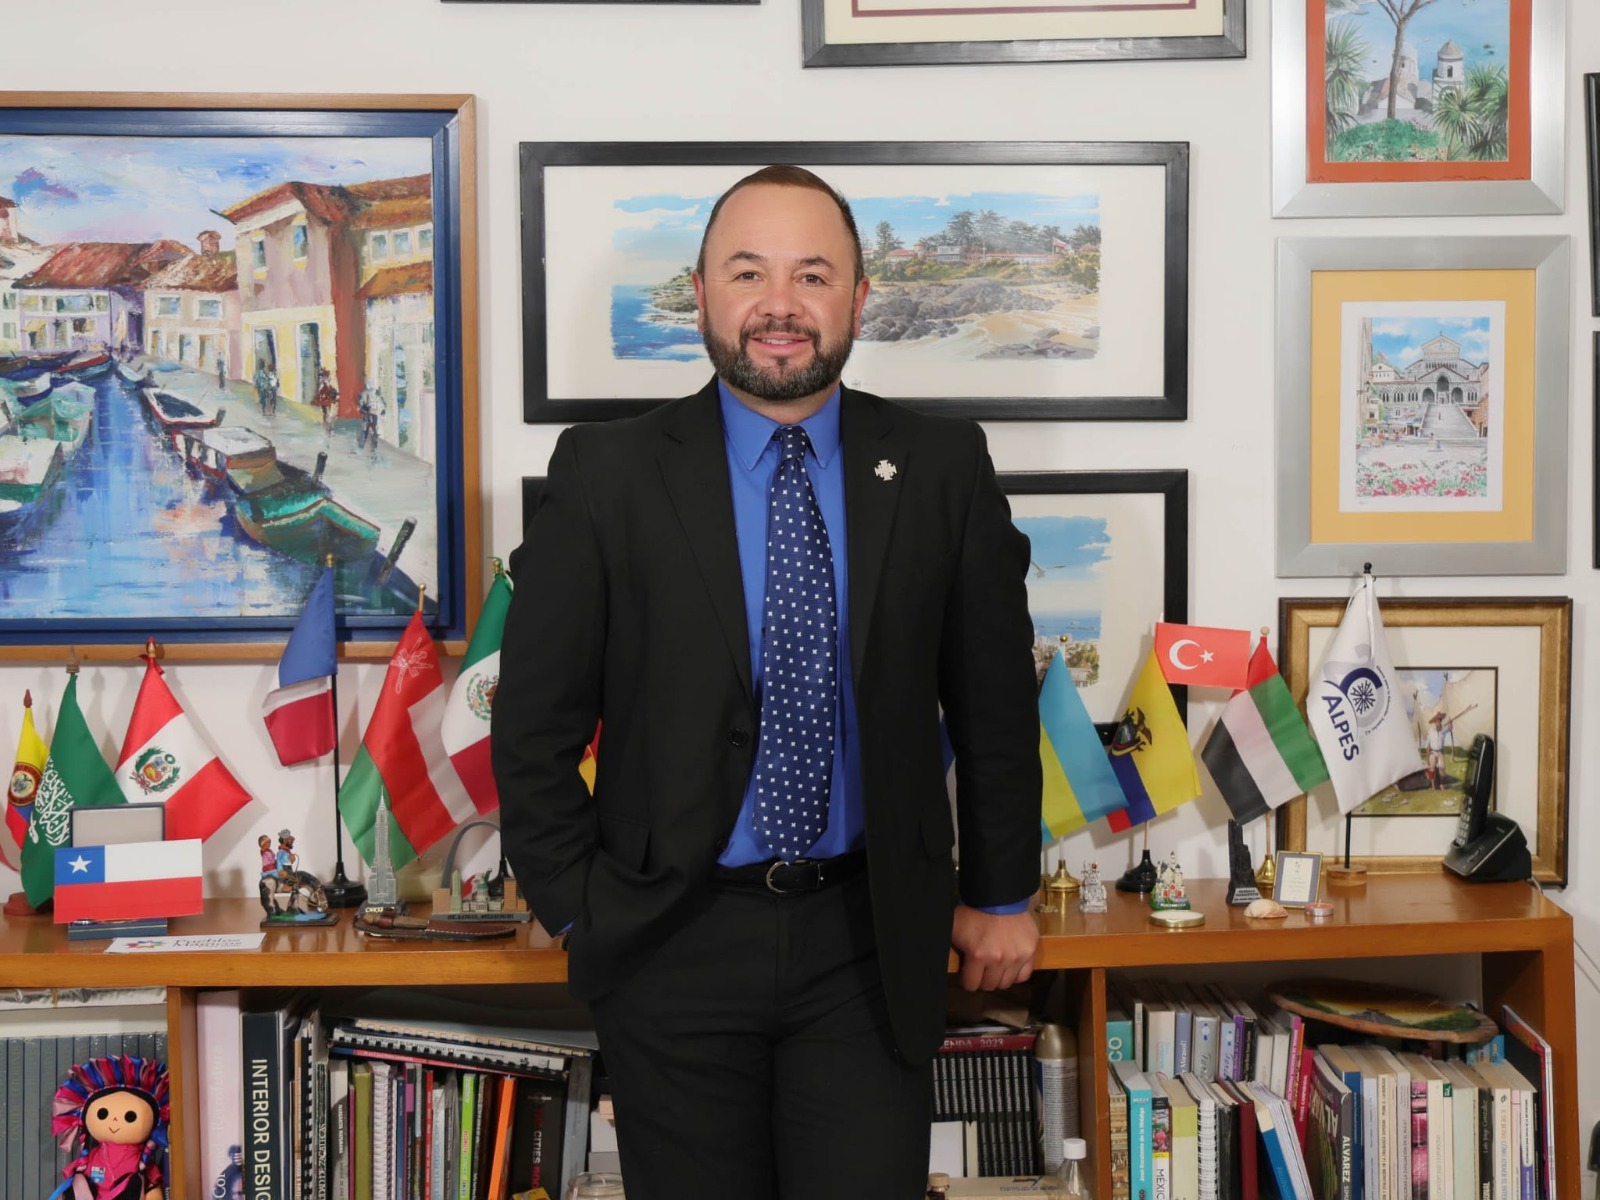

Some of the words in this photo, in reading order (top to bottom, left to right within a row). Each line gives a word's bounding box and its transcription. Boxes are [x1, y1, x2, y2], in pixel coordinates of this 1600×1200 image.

[1321, 695, 1360, 761] ALPES
[943, 1039, 973, 1049] ENDA
[1108, 1037, 1122, 1062] CO
[252, 1059, 271, 1144] INTERIOR
[1138, 1107, 1146, 1128] Hidalgo
[532, 1131, 542, 1164] CITIES
[1342, 1136, 1351, 1183] ALVAREZ
[531, 1166, 541, 1189] BOO
